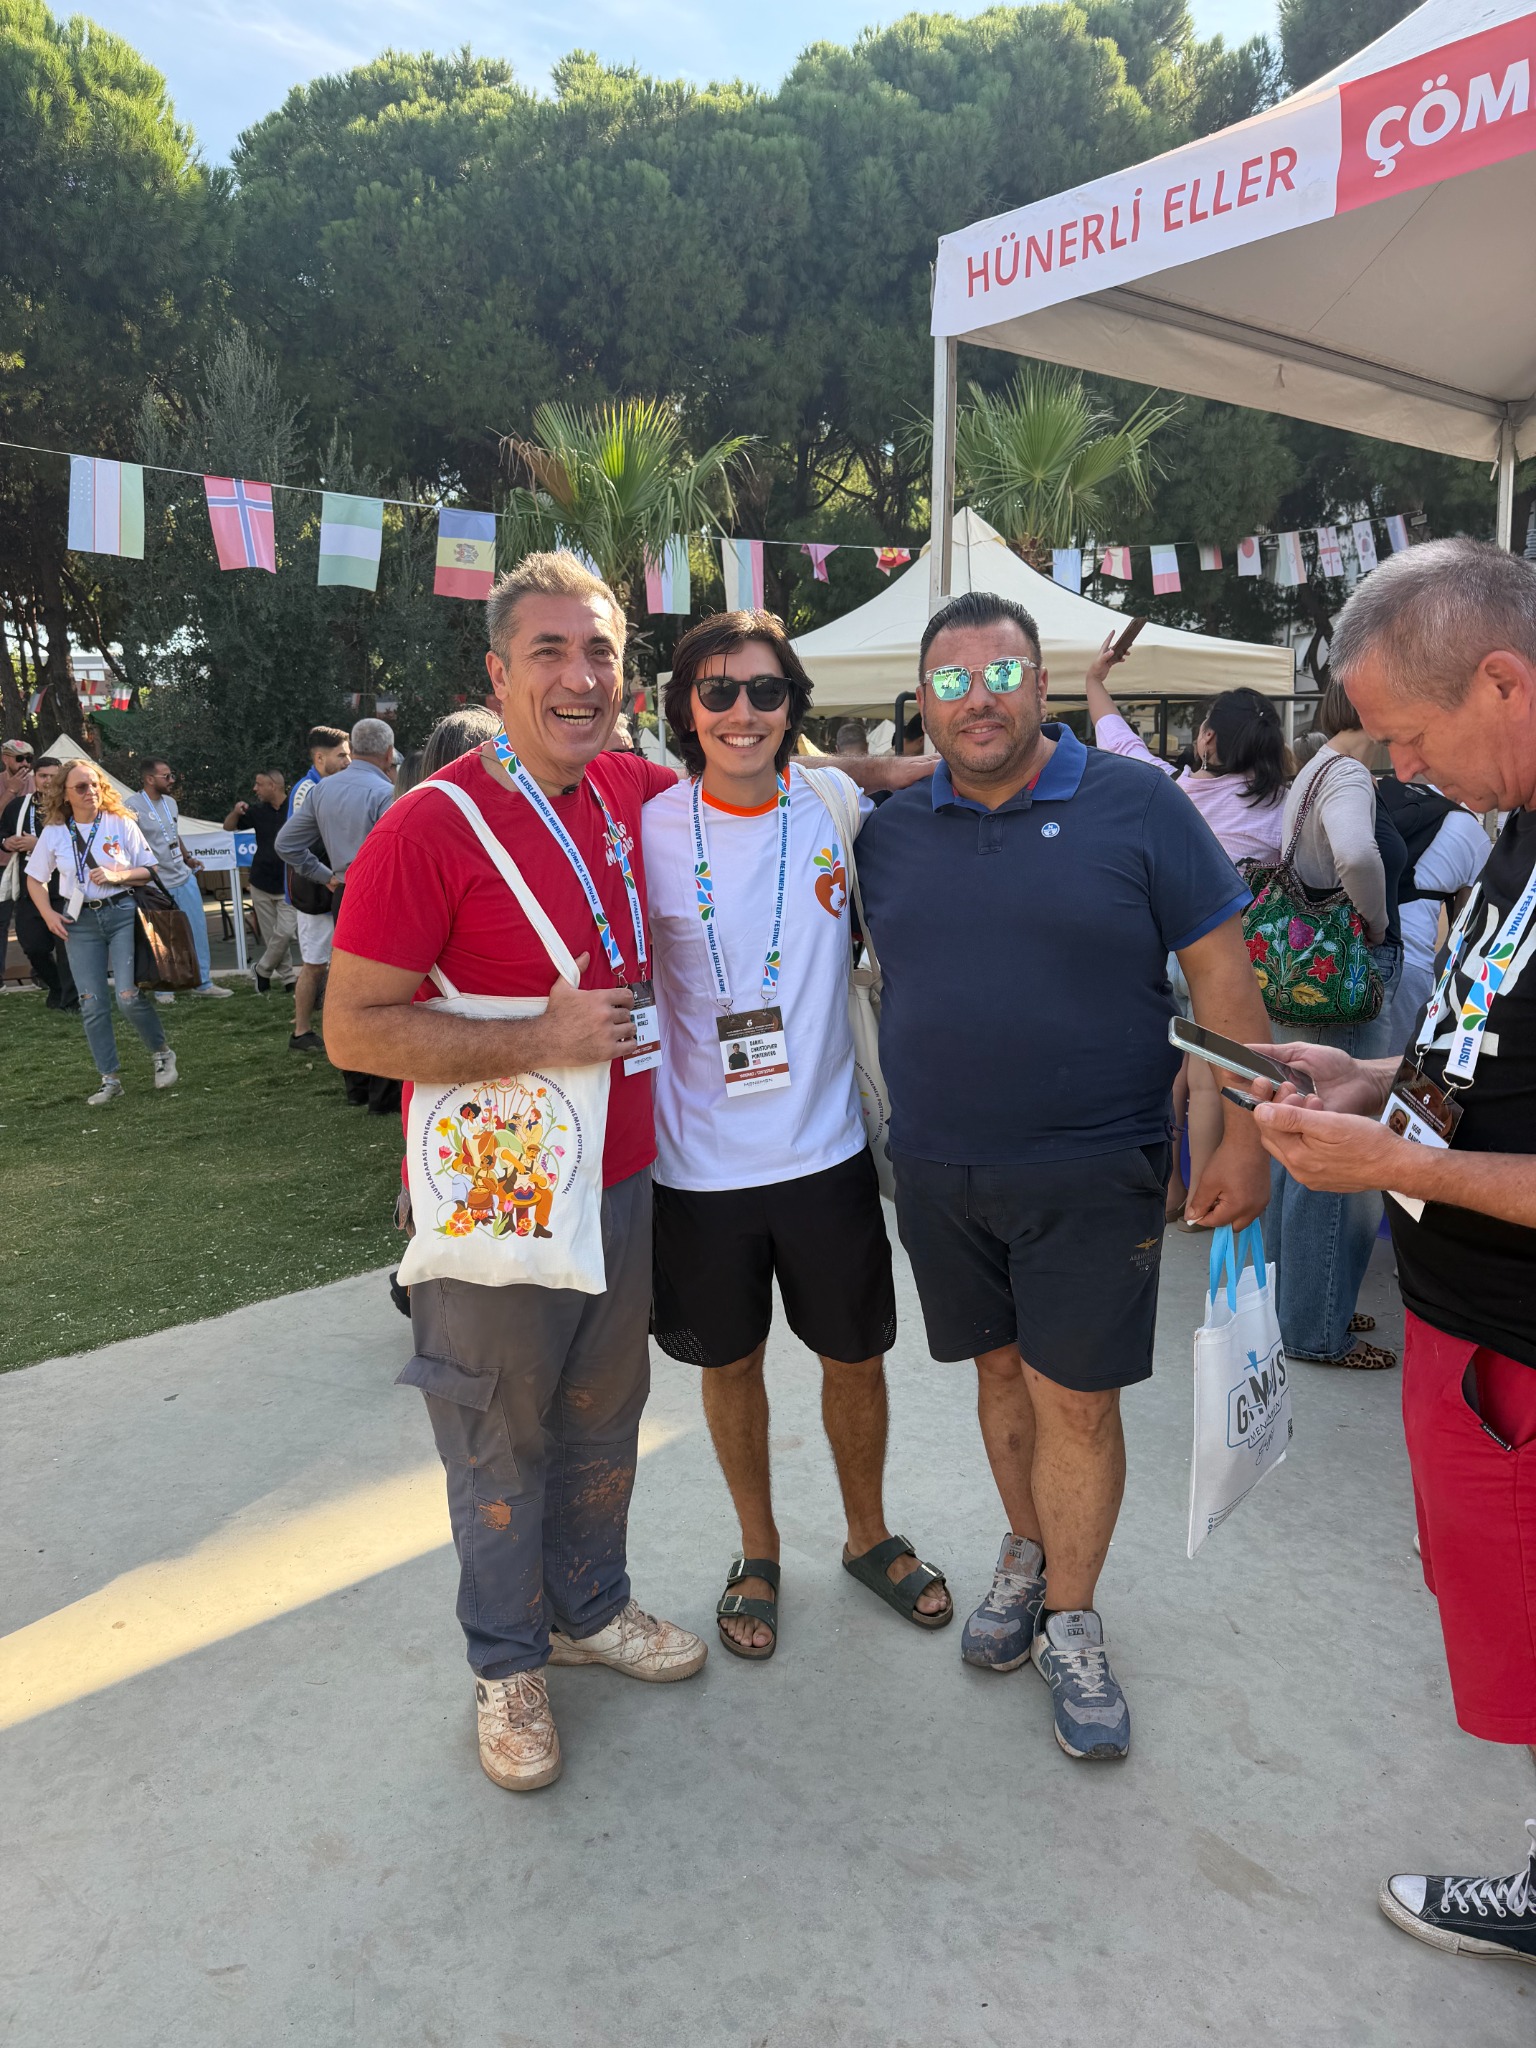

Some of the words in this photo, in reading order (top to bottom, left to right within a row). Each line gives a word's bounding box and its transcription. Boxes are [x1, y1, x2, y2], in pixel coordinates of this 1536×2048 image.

[966, 187, 1144, 299] HÜNERLİ
[1162, 146, 1298, 233] ELLER
[517, 773, 551, 818] ULUSLARARASI
[548, 817, 570, 848] MENEMEN
[567, 848, 585, 874] ÇÖMLEK
[693, 813, 704, 859] ULUSLARARASI
[780, 812, 788, 859] INTERNATIONAL
[195, 848, 231, 856] Pehlivan
[238, 843, 257, 854] 60
[778, 860, 786, 891] MENEMEN
[775, 891, 784, 919] POTTERY
[1506, 895, 1533, 937] FESTIVAL
[706, 923, 717, 951] FESTIVAL
[771, 919, 781, 948] FESTIVAL
[712, 951, 723, 978] POTTERY
[434, 1086, 458, 1110] ÇÖMLEK
[422, 1110, 437, 1147] MENEMEN
[564, 1099, 582, 1132] MENEMEN
[421, 1149, 444, 1201] ULUSLARARASI
[561, 1166, 578, 1195] FESTIVAL
